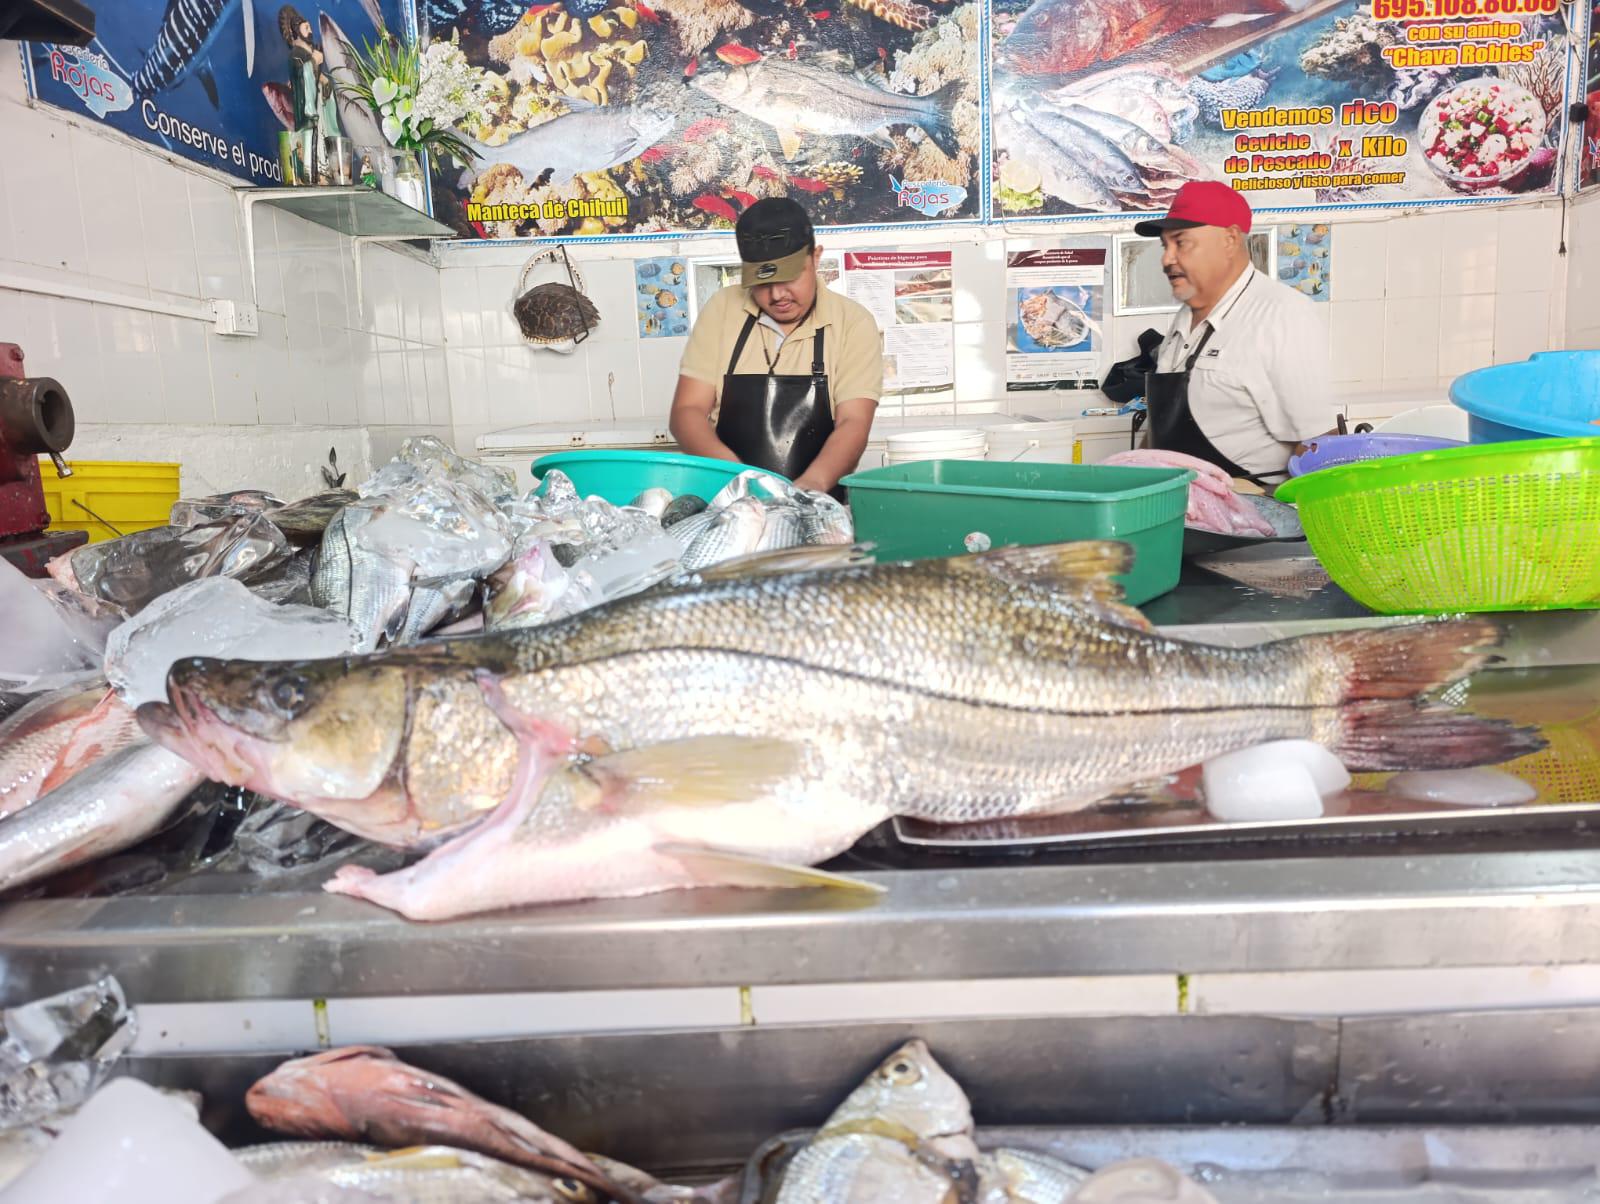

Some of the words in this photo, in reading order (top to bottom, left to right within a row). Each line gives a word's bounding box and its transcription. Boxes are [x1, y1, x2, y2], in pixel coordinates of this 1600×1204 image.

[1408, 27, 1441, 41] con
[1443, 25, 1465, 40] su
[1466, 21, 1521, 39] amigo
[50, 51, 115, 101] Rojas
[1221, 107, 1333, 128] Vendemos
[1342, 100, 1397, 126] rico
[142, 98, 228, 160] Conserve
[232, 142, 245, 167] el
[1235, 133, 1311, 153] Ceviche
[1338, 140, 1352, 157] x
[1362, 136, 1407, 158] Kilo
[1225, 156, 1249, 174] de
[1251, 152, 1332, 172] Pescado
[1232, 178, 1291, 190] Delicioso
[1292, 178, 1301, 189] y
[1302, 175, 1331, 188] listo
[1332, 174, 1363, 187] para
[1364, 172, 1405, 184] comer
[467, 203, 540, 221] Manteca
[543, 200, 564, 218] de
[566, 197, 629, 217] Chihuil
[898, 190, 949, 209] Rojas
